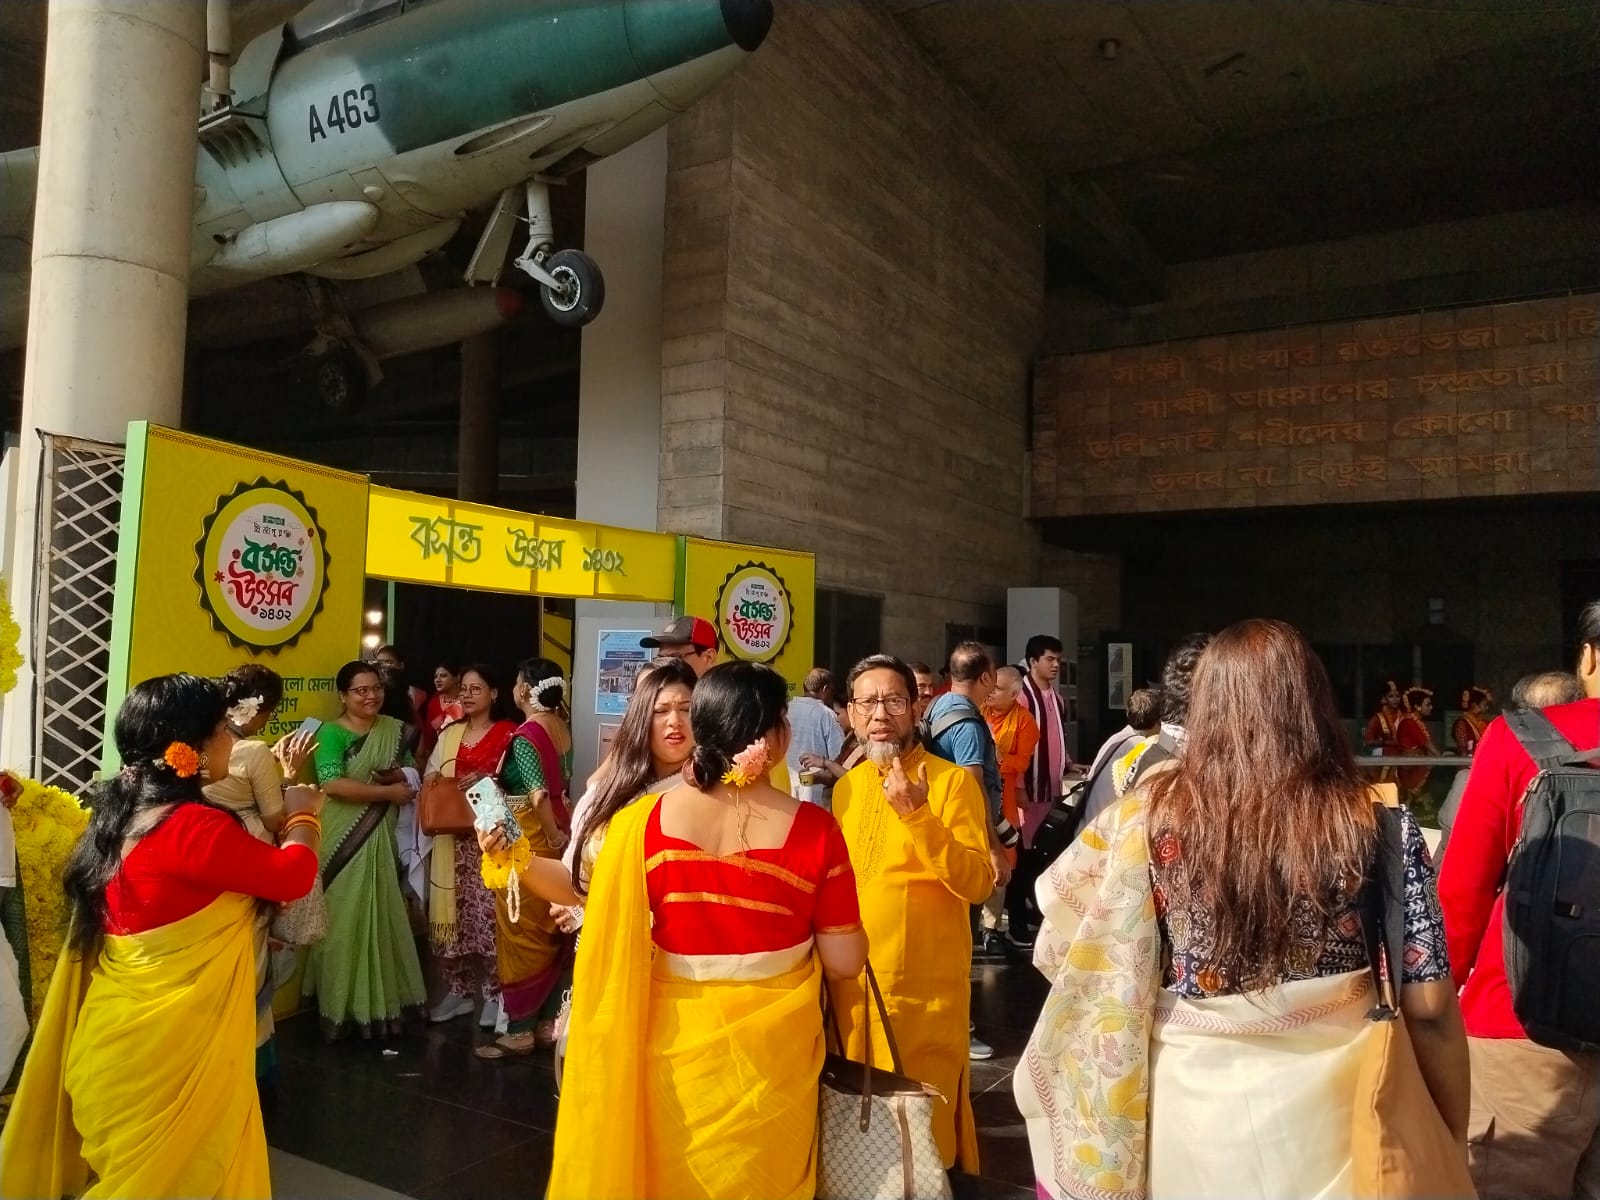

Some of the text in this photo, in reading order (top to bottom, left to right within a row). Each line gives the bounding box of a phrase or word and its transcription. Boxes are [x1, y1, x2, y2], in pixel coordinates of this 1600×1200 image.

[1201, 345, 1317, 375] বাংলার
[1230, 379, 1391, 409] আকাশের
[241, 535, 302, 578] বসন্ত
[408, 516, 628, 577] বসন্ত উৎসব ১৪৩২
[228, 560, 299, 608] উৎসব
[259, 608, 292, 621] ১৪৩২
[740, 597, 775, 621] বসন্ত
[732, 612, 774, 640] উৎসব
